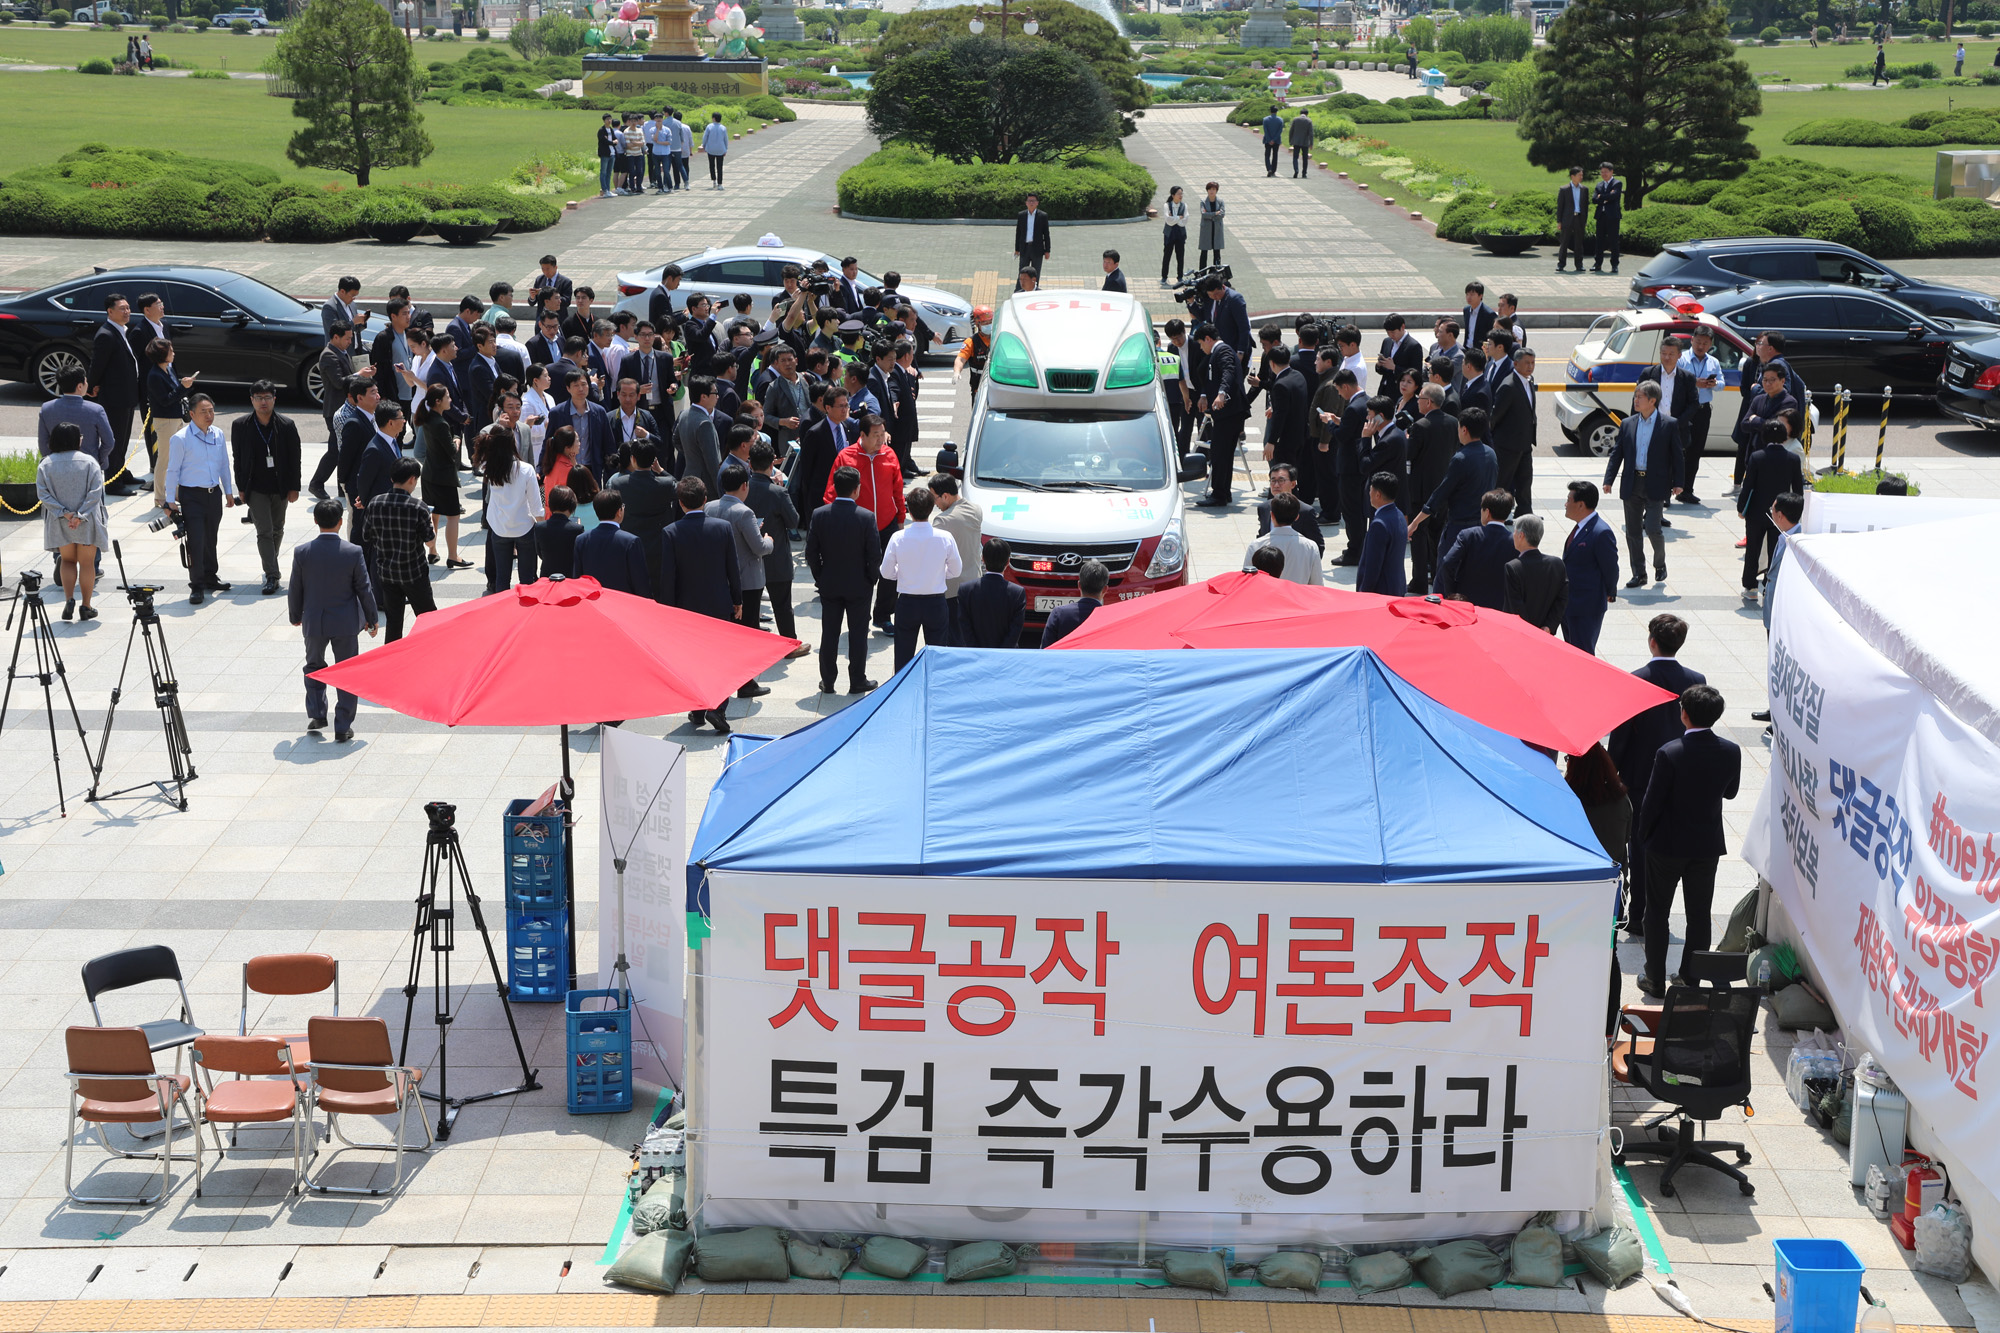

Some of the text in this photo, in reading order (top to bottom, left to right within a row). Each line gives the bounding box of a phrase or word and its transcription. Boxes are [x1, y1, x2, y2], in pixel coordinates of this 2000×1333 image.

[604, 80, 634, 93] 지혜와
[701, 82, 740, 94] 아름답게
[1770, 638, 1826, 745] 황제갑질
[1829, 757, 1913, 908] 댓글공작
[1927, 791, 1977, 882] #me
[763, 906, 1550, 1038] 댓글공작 여론조작
[1854, 901, 1898, 1017] 제왕적
[759, 1059, 1528, 1195] 특검 즉각수용하라
